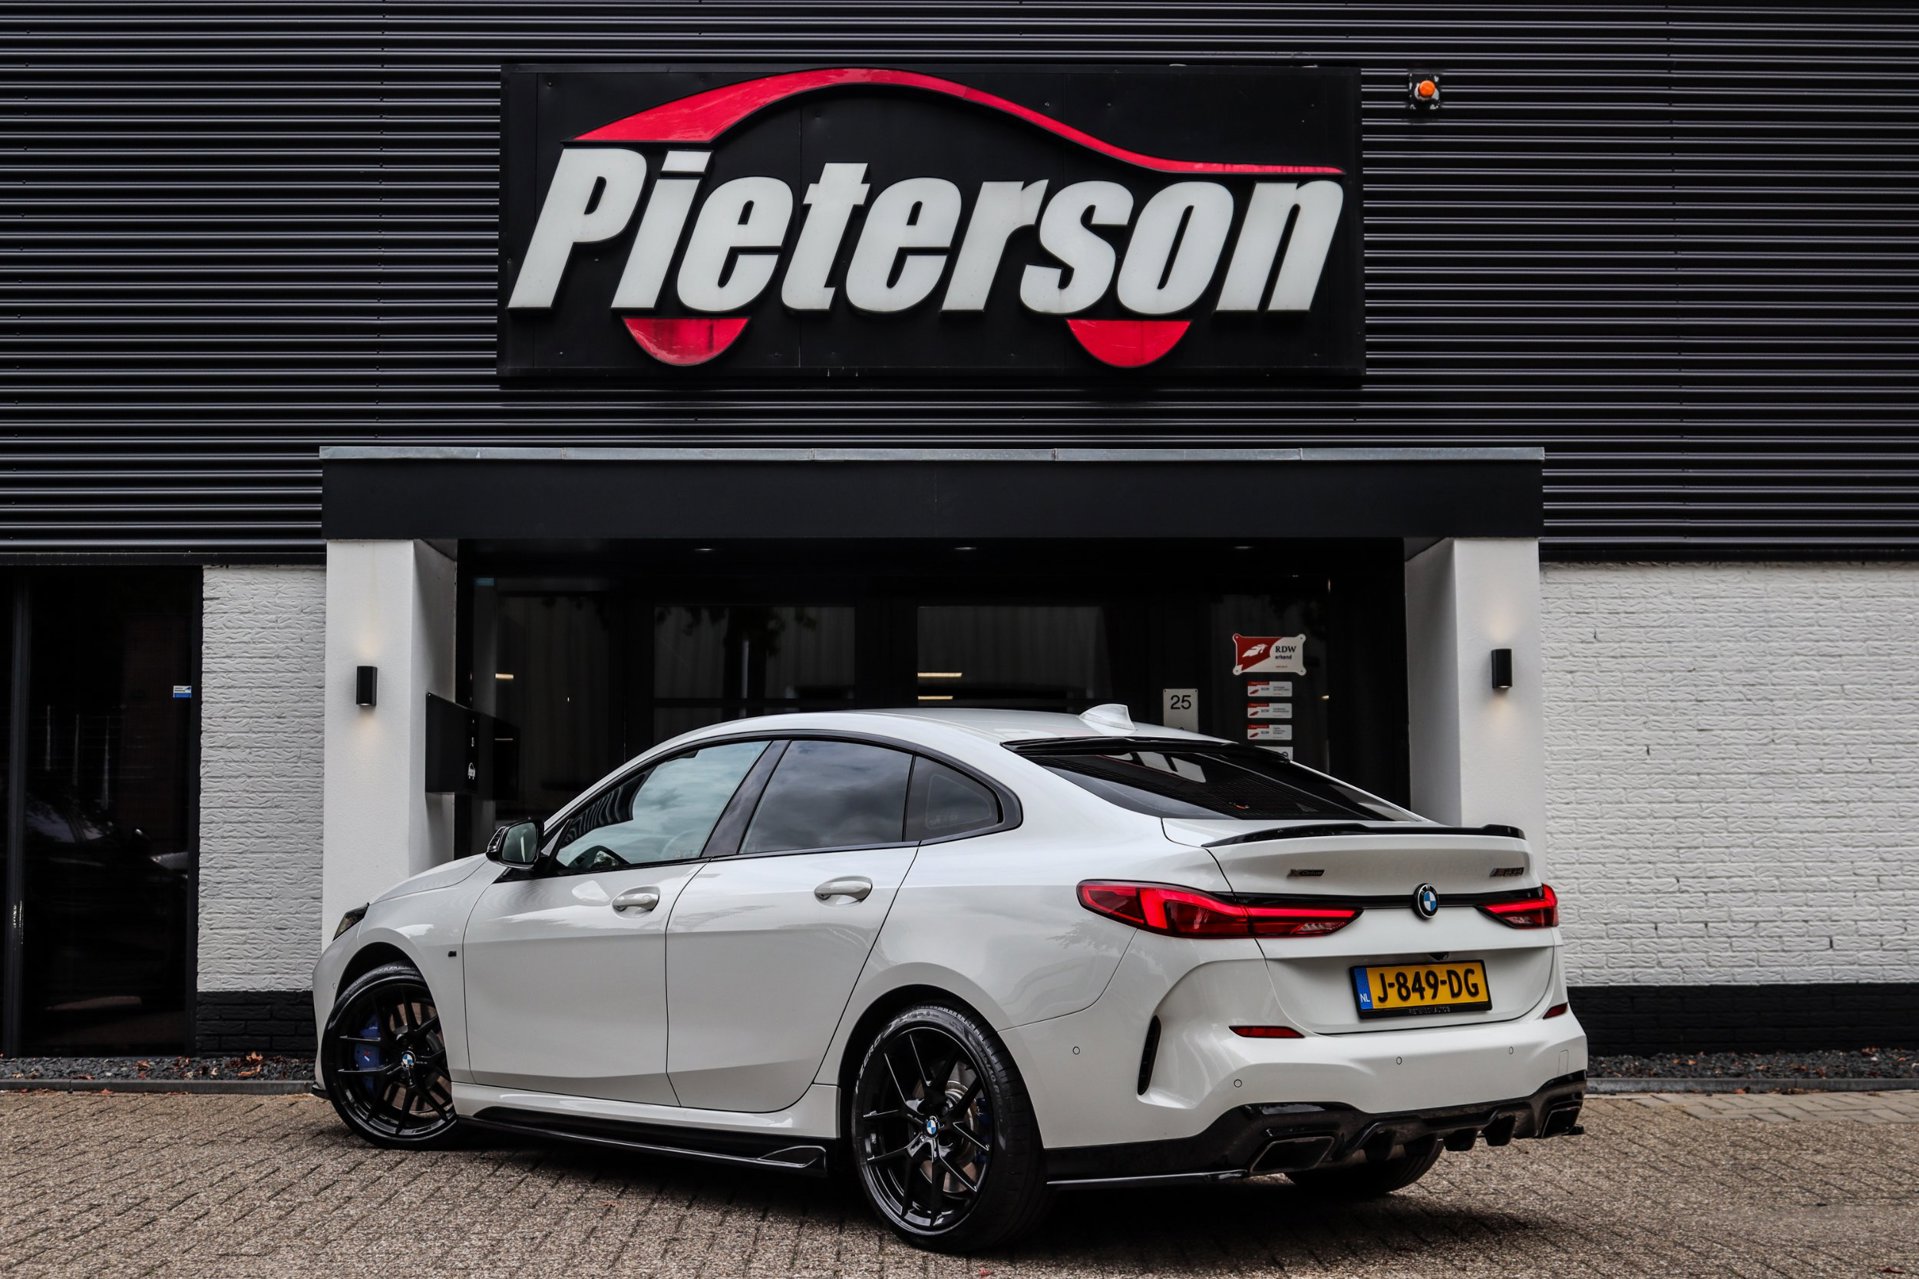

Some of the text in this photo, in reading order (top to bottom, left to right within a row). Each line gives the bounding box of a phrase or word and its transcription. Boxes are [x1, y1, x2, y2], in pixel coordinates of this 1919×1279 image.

[507, 146, 1345, 315] Pieterson
[1275, 645, 1297, 653] RDW
[1170, 694, 1192, 710] 25
[1377, 968, 1480, 1003] J-849-DG
[1359, 993, 1370, 1003] NL
